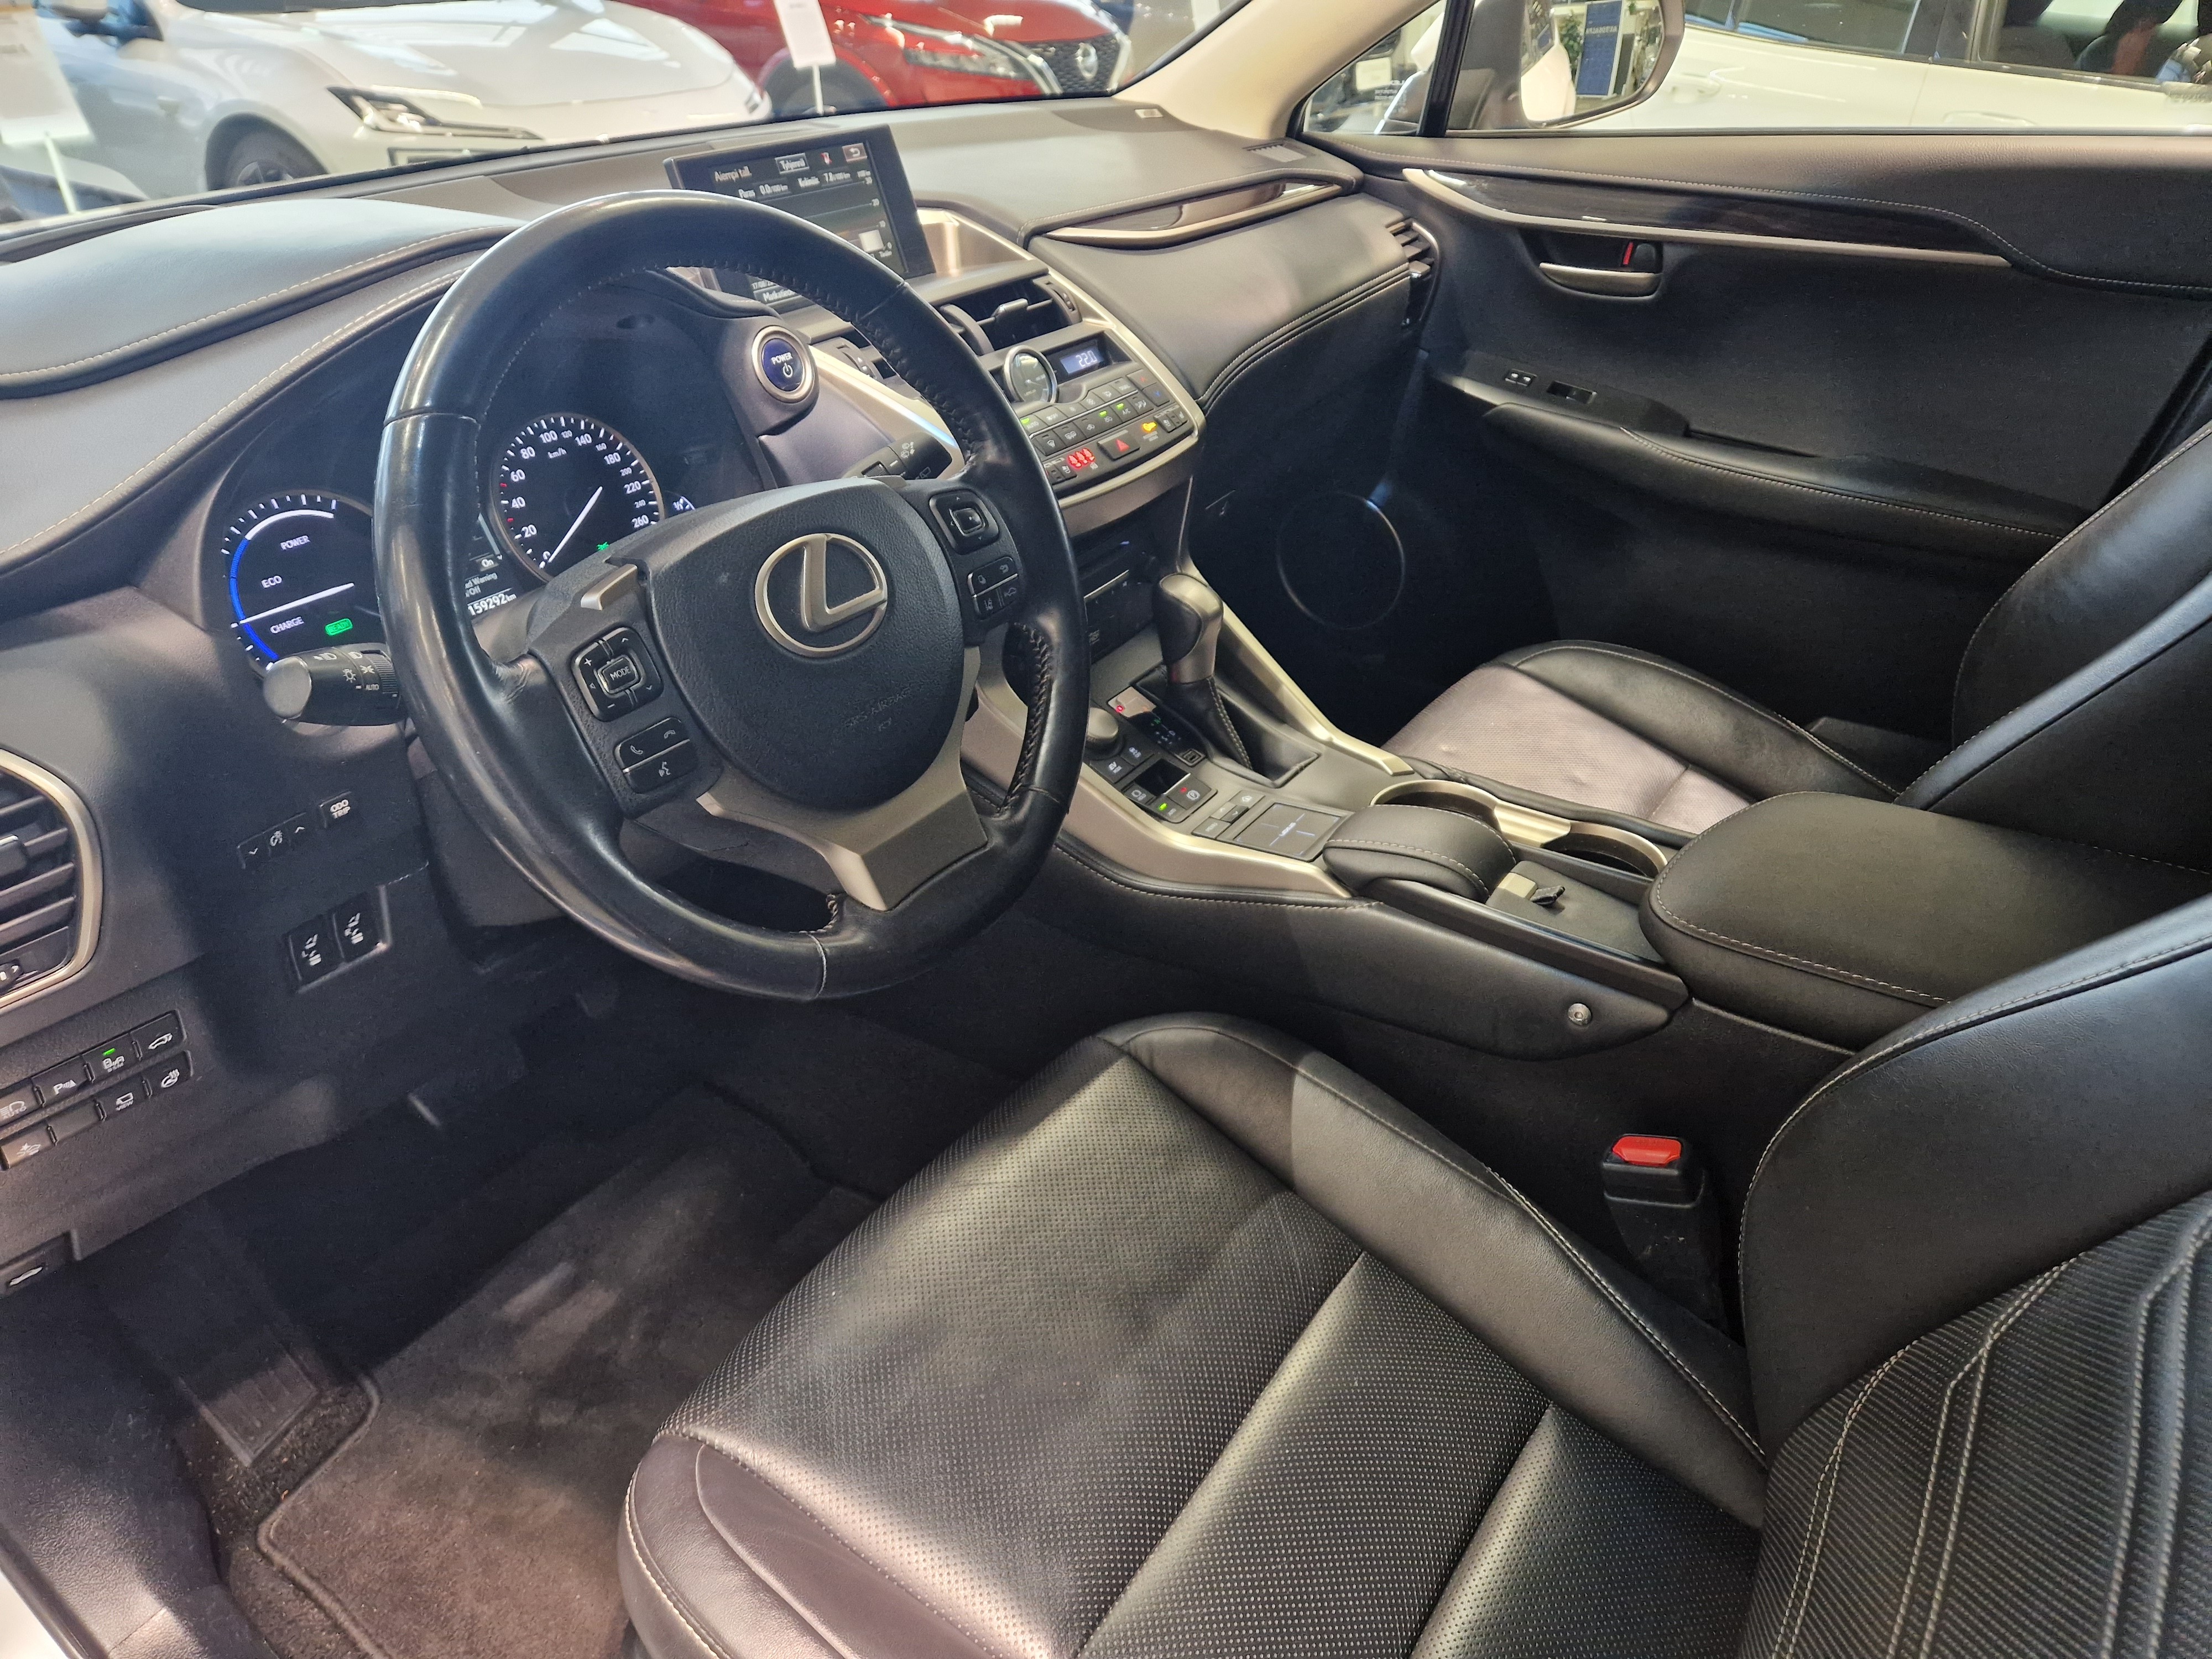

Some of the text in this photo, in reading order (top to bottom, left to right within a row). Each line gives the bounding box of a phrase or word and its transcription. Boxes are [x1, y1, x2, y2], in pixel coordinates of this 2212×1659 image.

[771, 352, 793, 365] POWER
[539, 430, 558, 444] 100
[561, 430, 573, 439] 120
[575, 433, 592, 446] 140
[520, 446, 535, 460] 80
[547, 447, 567, 459] km/h
[595, 442, 607, 452] 160
[604, 452, 621, 465] 180
[510, 469, 526, 483] 60
[619, 467, 632, 476] 200
[623, 481, 641, 494] 220
[512, 496, 526, 509] 40
[634, 499, 646, 509] 240
[632, 514, 649, 529] 260
[521, 524, 538, 538] 20
[280, 535, 310, 550] POWER
[481, 559, 494, 567] On
[261, 575, 283, 589] ECO
[467, 593, 517, 615] 159292 km
[270, 616, 305, 634] CHARGE
[609, 666, 631, 681] MODE
[1109, 761, 1117, 771] EV
[332, 806, 351, 818] TRIP
